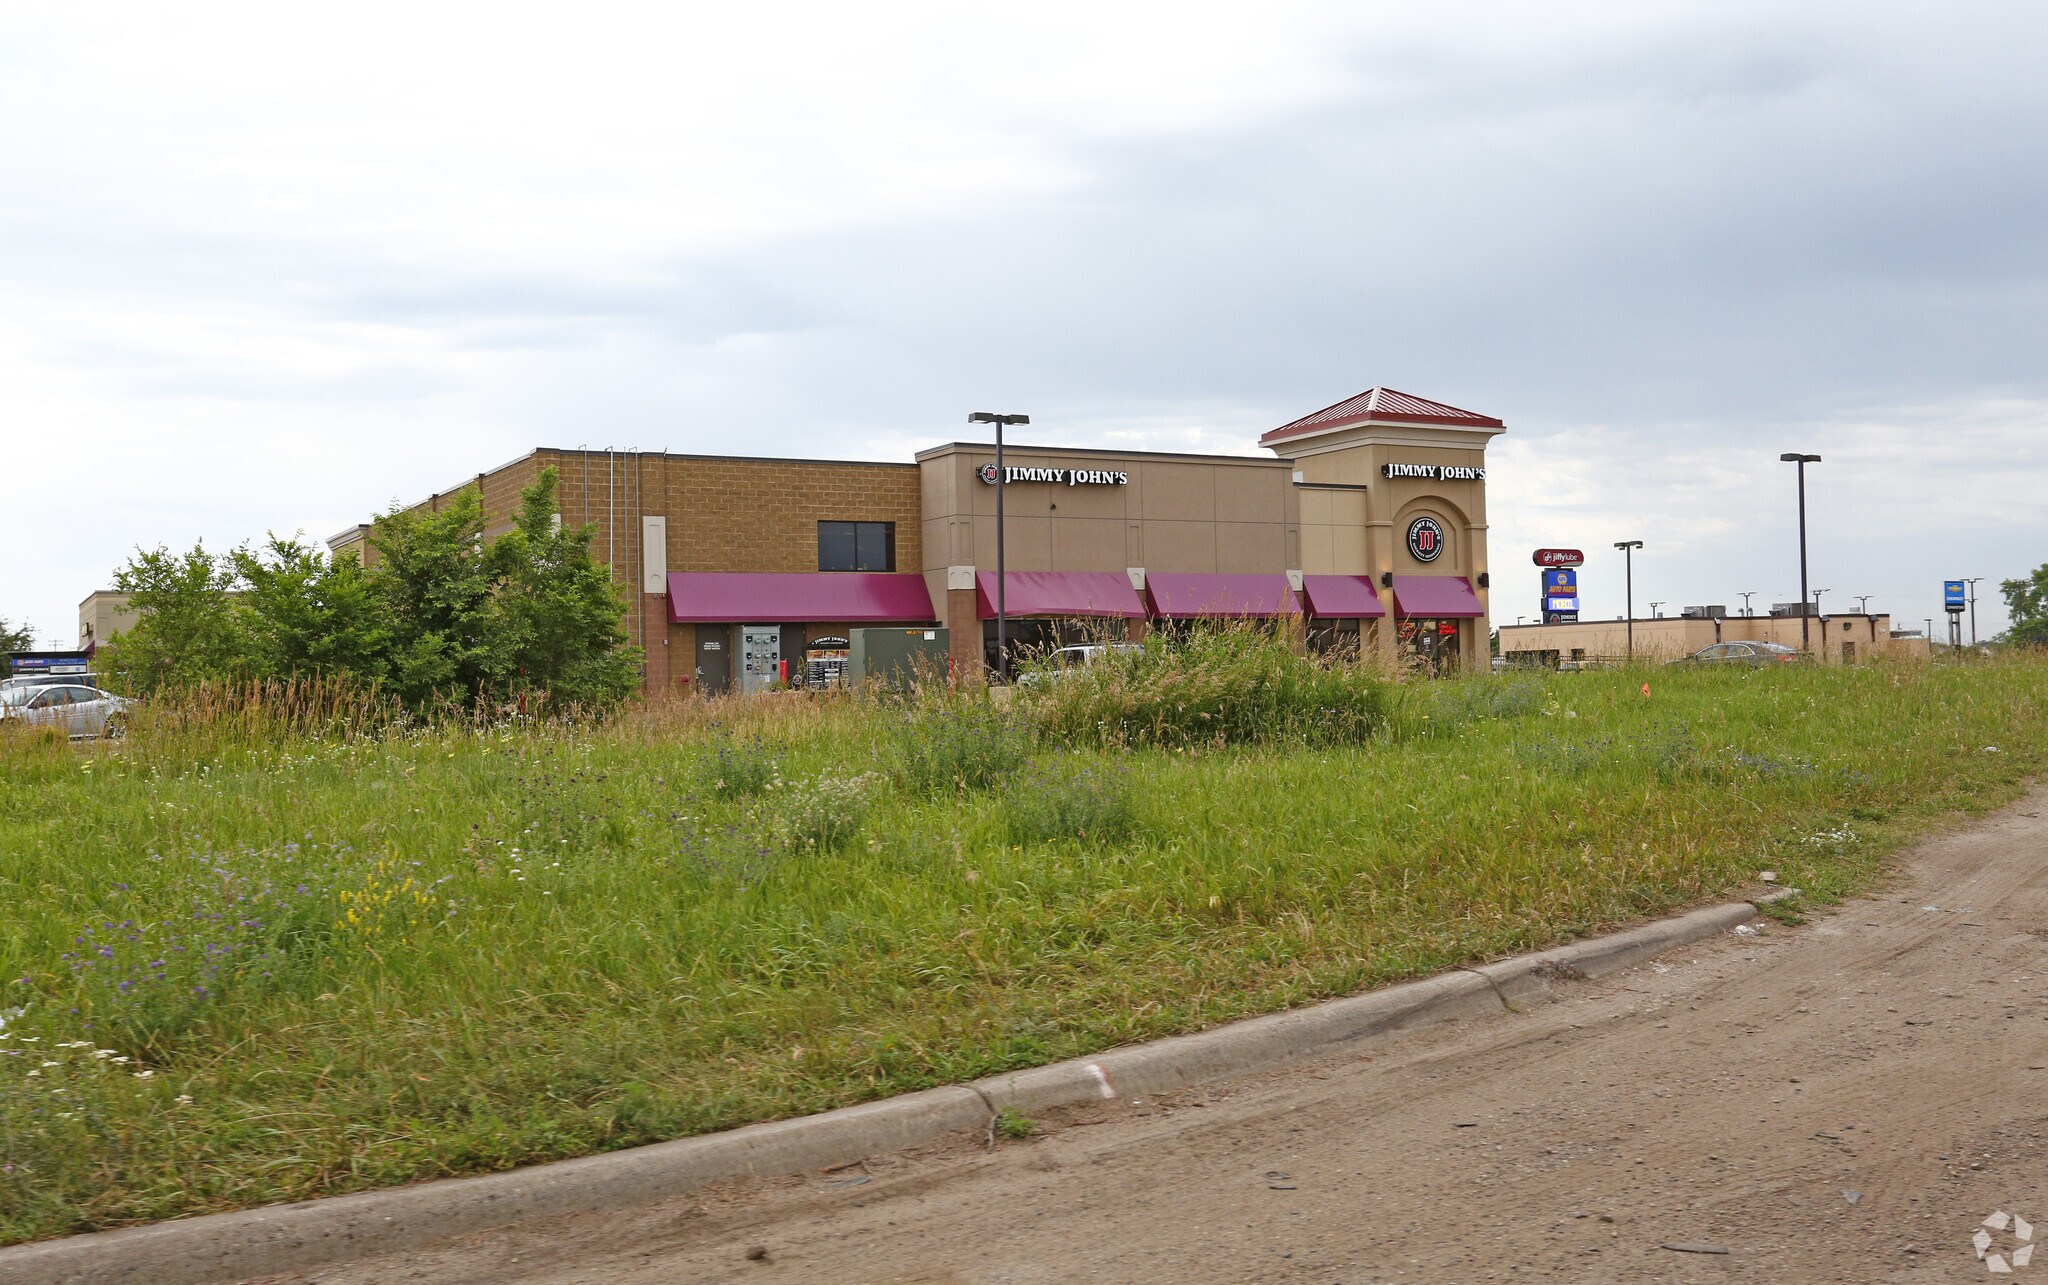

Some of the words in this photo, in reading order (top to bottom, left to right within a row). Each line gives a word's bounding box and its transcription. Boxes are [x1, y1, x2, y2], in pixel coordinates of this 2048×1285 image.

[1005, 467, 1065, 484] JIMMY
[1069, 469, 1128, 487] JOHN'S
[1388, 463, 1436, 479] JIMMY
[1440, 466, 1486, 481] JOHN'S
[1411, 521, 1426, 540] JIMMY
[1426, 520, 1441, 540] JOHN'S
[1419, 530, 1434, 550] JJ
[1549, 585, 1562, 593] AUTO
[1562, 585, 1577, 593] PARTS
[814, 636, 831, 645] JIMMY
